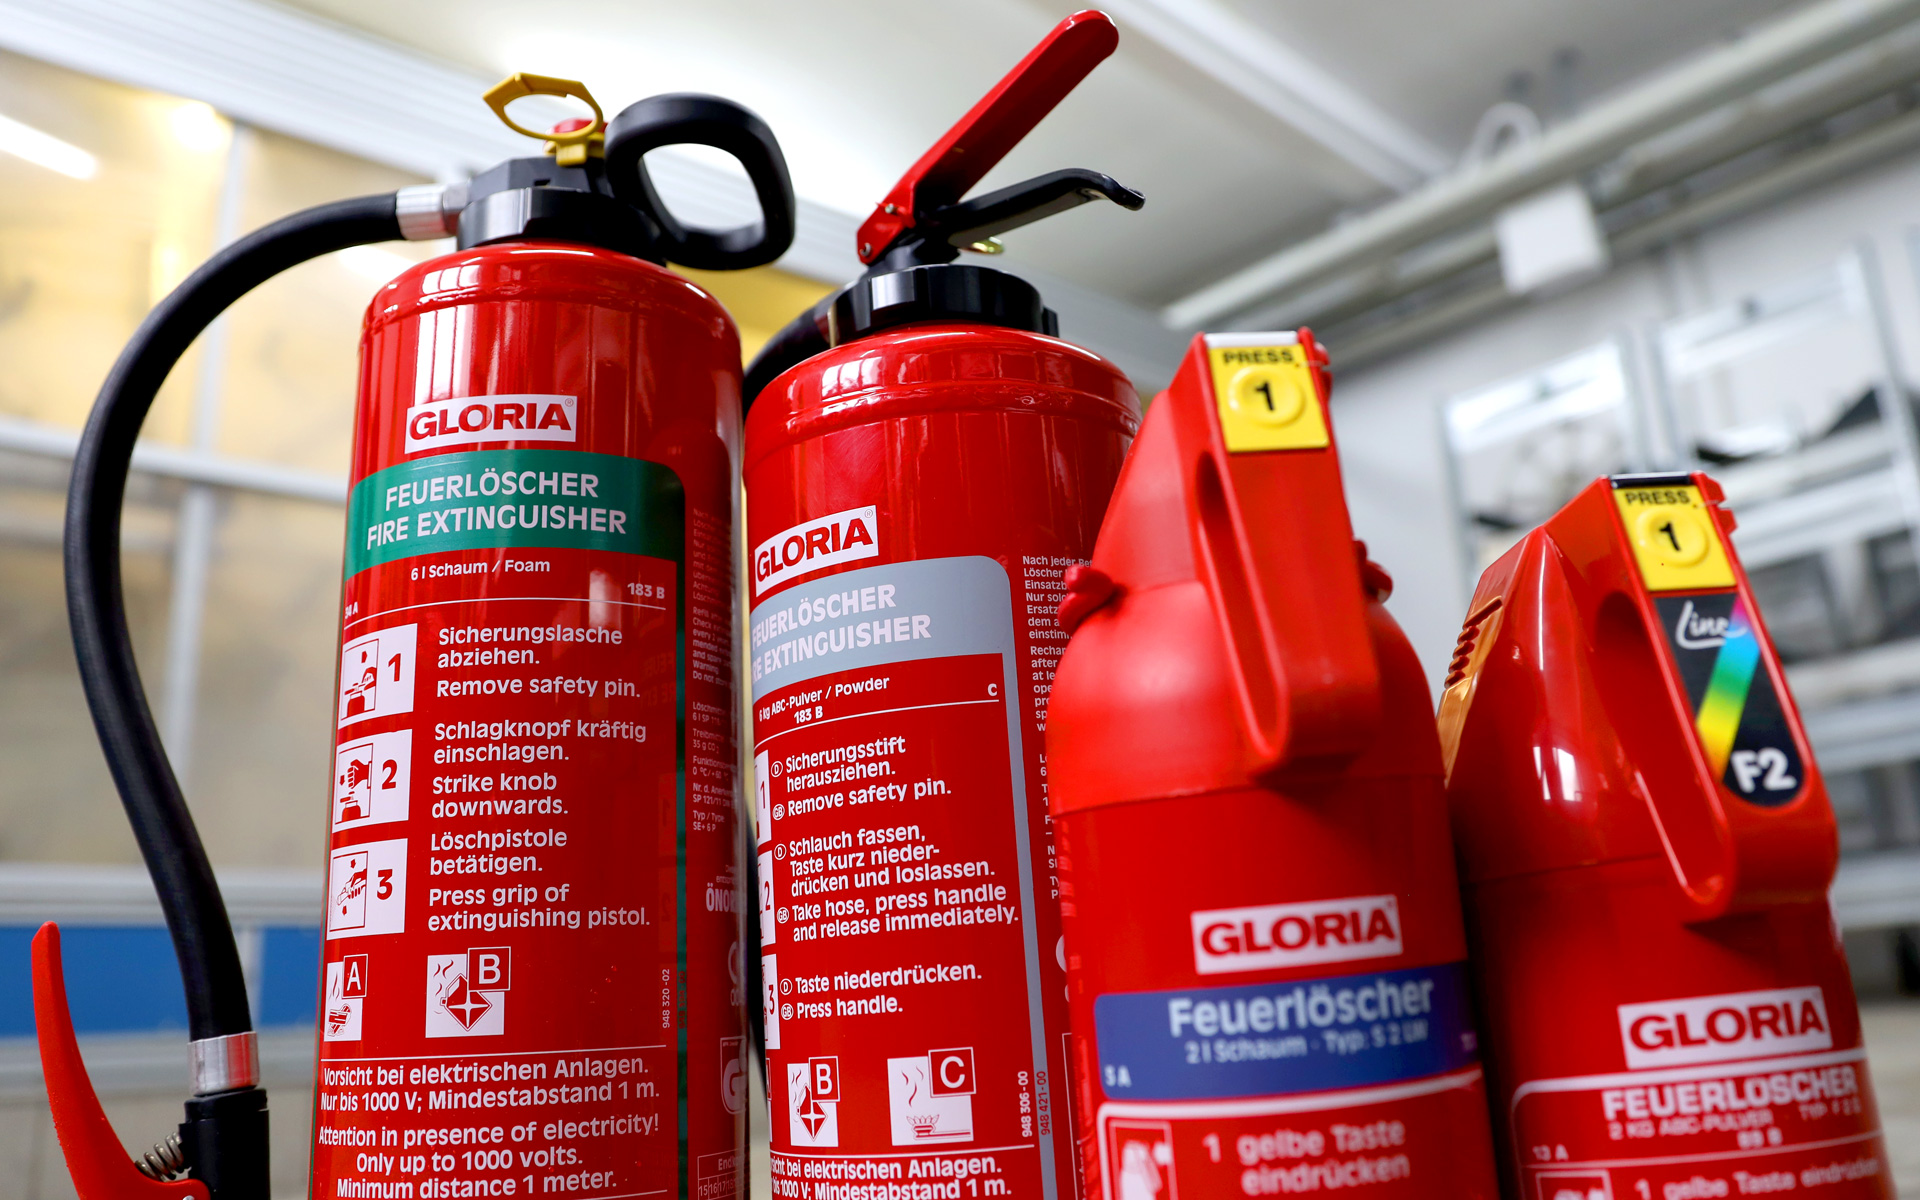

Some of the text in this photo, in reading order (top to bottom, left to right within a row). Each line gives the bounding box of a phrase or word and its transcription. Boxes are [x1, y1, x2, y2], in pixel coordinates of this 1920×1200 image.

[1223, 349, 1293, 363] PRESS
[1255, 380, 1274, 411] 1
[409, 402, 572, 440] GLORIA
[386, 468, 599, 511] FEUERLÖSCHER
[1625, 490, 1691, 505] PRESS
[367, 505, 626, 550] FIRE EXTINGUISHER
[1659, 522, 1681, 552] 1
[756, 518, 873, 582] GLORIA
[1023, 556, 1076, 566] Nach jeder
[411, 568, 418, 581] 6
[428, 560, 488, 578] Schaum
[505, 559, 550, 573] Foam
[1024, 568, 1062, 578] Löscher
[627, 583, 665, 599] 183 B
[1026, 593, 1044, 602] Nur
[752, 584, 896, 649] FEUERLÖSCHER
[1028, 617, 1051, 626] dem
[1676, 600, 1749, 650] Line
[439, 624, 622, 645] Sicherungslasche
[764, 615, 932, 674] EXTINGUISHER
[388, 653, 401, 682] 1
[438, 648, 540, 668] abziehen.
[693, 650, 706, 660] and
[1032, 658, 1058, 668] after
[437, 676, 640, 698] Remove safety pin.
[693, 671, 702, 680] Do
[988, 683, 997, 697] C
[1033, 671, 1044, 680] at
[763, 706, 770, 721] kg
[771, 689, 822, 714] ABC-Pulver
[835, 676, 889, 697] Powder
[793, 706, 823, 724] 183 B
[434, 719, 646, 742] Schlagknopf kräftig
[434, 743, 569, 764] einschlagen.
[786, 736, 906, 773] Sicherungsstift
[382, 759, 398, 790] 2
[432, 772, 557, 794] Strike knob
[786, 761, 896, 792] herausziehen.
[1731, 747, 1798, 792] F2
[432, 797, 568, 818] downwards.
[760, 781, 766, 809] 1
[788, 778, 951, 816] Remove safety pin.
[692, 810, 705, 821] Typ
[431, 828, 567, 851] Löschpistole
[789, 824, 926, 857] Schlauch fassen,
[430, 856, 542, 875] betätigen.
[790, 843, 940, 877] Taste kurz nieder-
[376, 869, 393, 900] 3
[791, 860, 995, 897] drücken und loslassen.
[429, 884, 570, 906] Press grip of
[764, 881, 770, 911] 2
[792, 883, 1006, 921] Take hose, press handle
[428, 907, 650, 932] extinguishing pistol.
[793, 904, 1018, 942] and release immediately.
[1201, 908, 1396, 957] GLORIA
[346, 961, 361, 990] A
[479, 954, 501, 984] B
[795, 964, 982, 995] Taste niederdrücken.
[662, 988, 670, 1006] 320
[769, 984, 774, 1015] 3
[797, 995, 903, 1018] Press handle.
[1168, 978, 1434, 1038] Feuerlöscher
[662, 1010, 670, 1028] 948
[1630, 999, 1824, 1052] GLORIA
[1215, 1033, 1307, 1062] Schaum
[324, 1056, 649, 1087] Vorsicht bei elektrischen Anlagen.
[816, 1063, 832, 1095] B
[940, 1056, 965, 1088] C
[321, 1081, 659, 1114] Nur bis 1000 V; Mindestabstand 1 m.
[319, 1113, 659, 1149] Attention in presence of electricity!
[1021, 1115, 1032, 1138] 948
[1040, 1114, 1050, 1136] 948
[1203, 1133, 1222, 1162] 1
[1236, 1120, 1406, 1165] gelbe Taste
[357, 1147, 582, 1176] Only up to 1000 volts.
[787, 1156, 1002, 1180] bei elektrischen Anlagen.
[1241, 1154, 1410, 1196] eindrücken
[337, 1170, 617, 1199] Minimum distance 1 meter.
[780, 1177, 1012, 1200] 1000 V; Mindestabstand 1 m.
